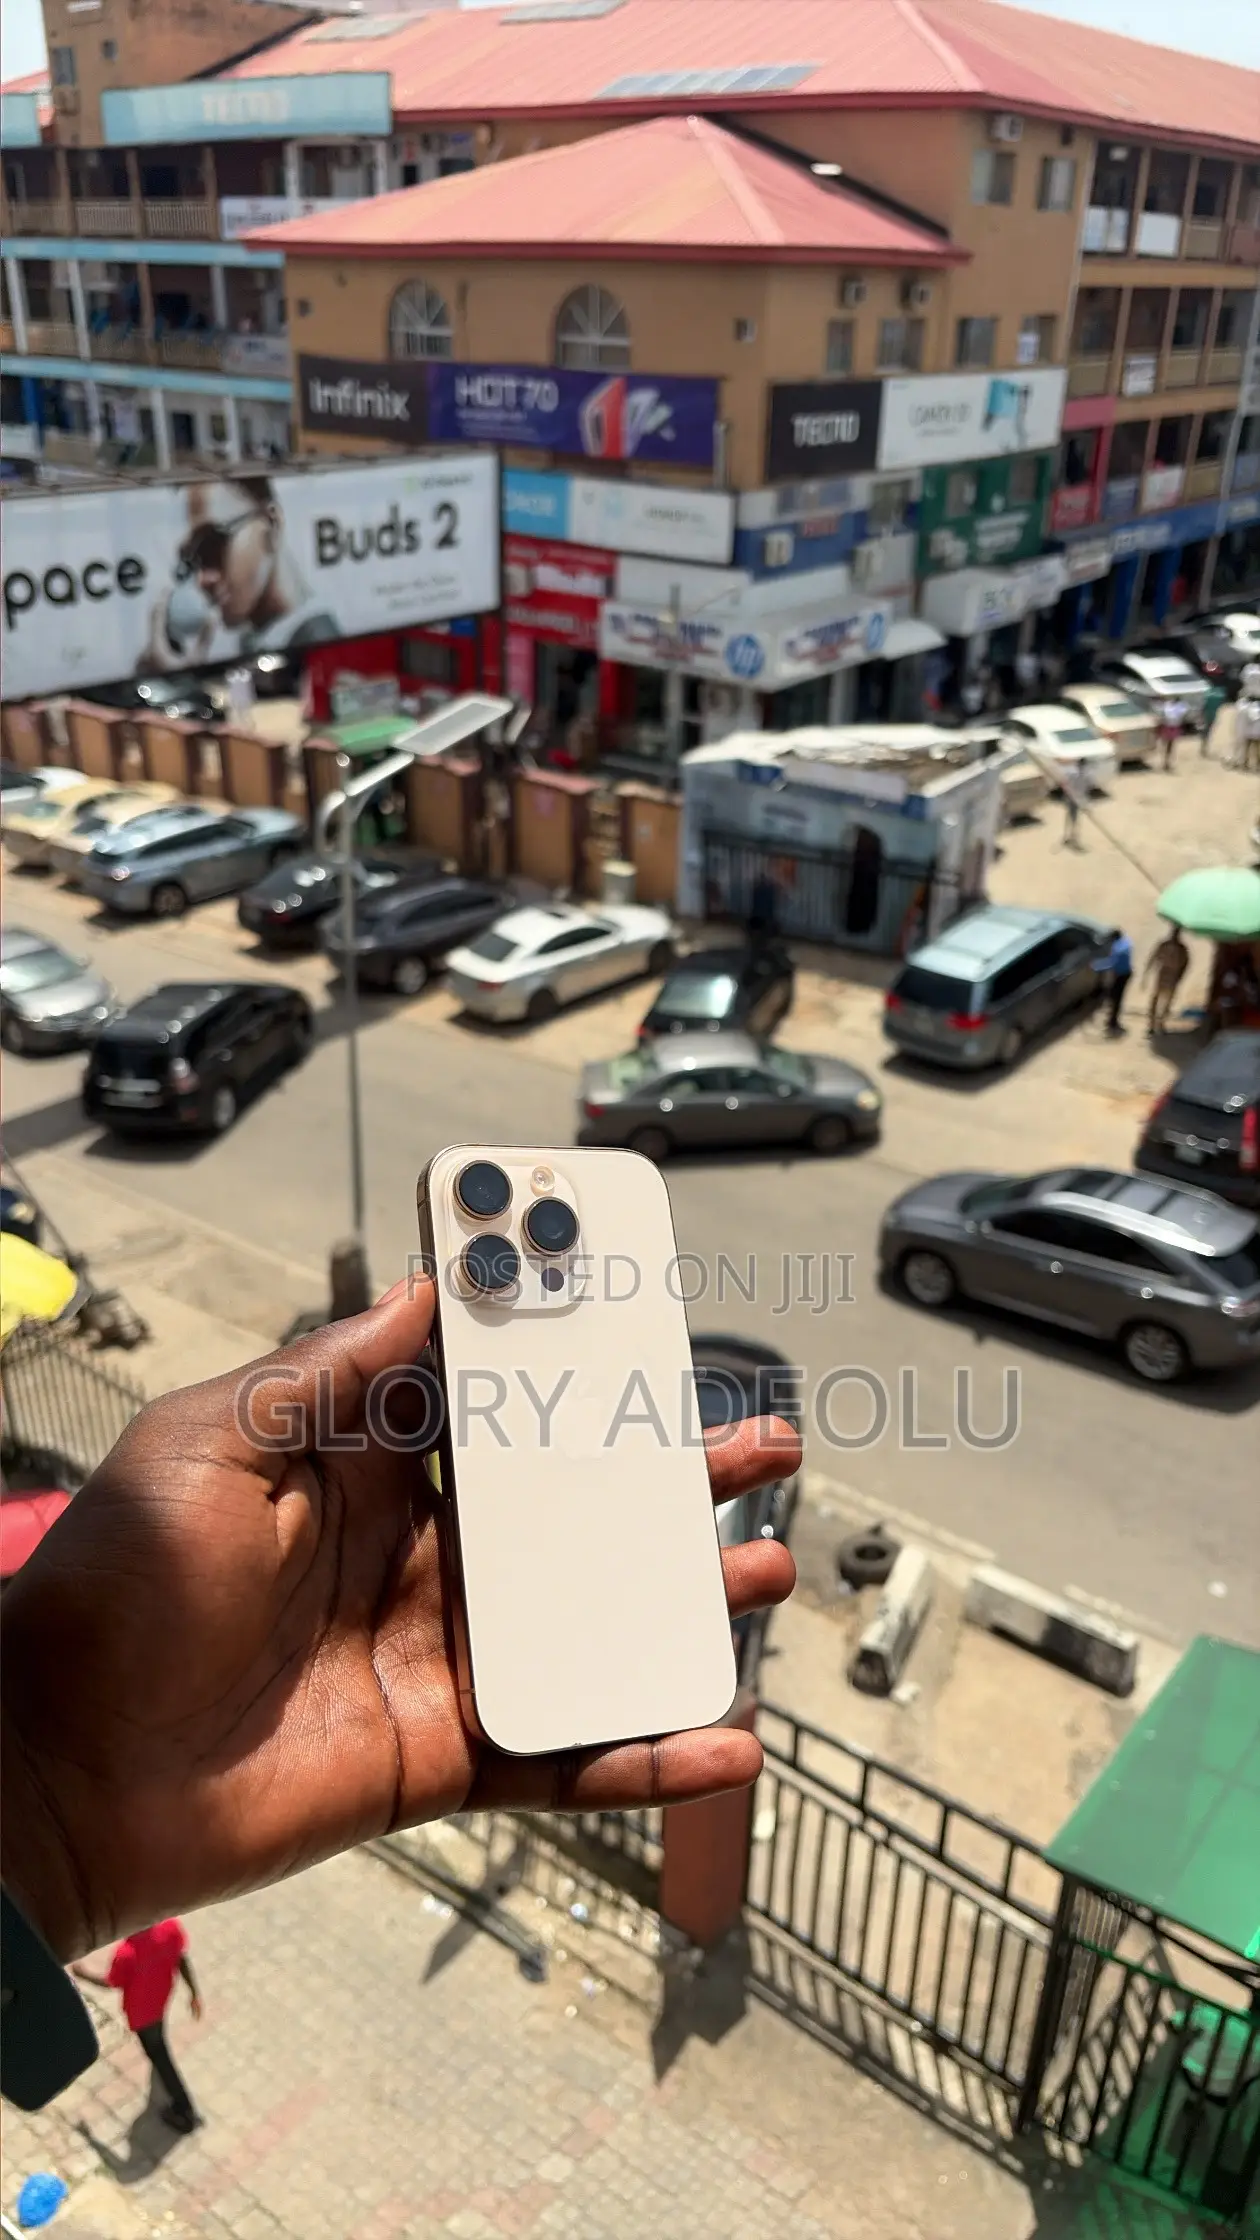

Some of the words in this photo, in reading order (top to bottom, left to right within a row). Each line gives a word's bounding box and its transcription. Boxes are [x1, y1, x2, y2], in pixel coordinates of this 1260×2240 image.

[310, 377, 411, 421] Infinix
[454, 375, 521, 409] HOT
[792, 411, 860, 447] TECNO
[316, 503, 420, 568] Buds
[433, 501, 460, 549] 2
[4, 556, 145, 631] pace
